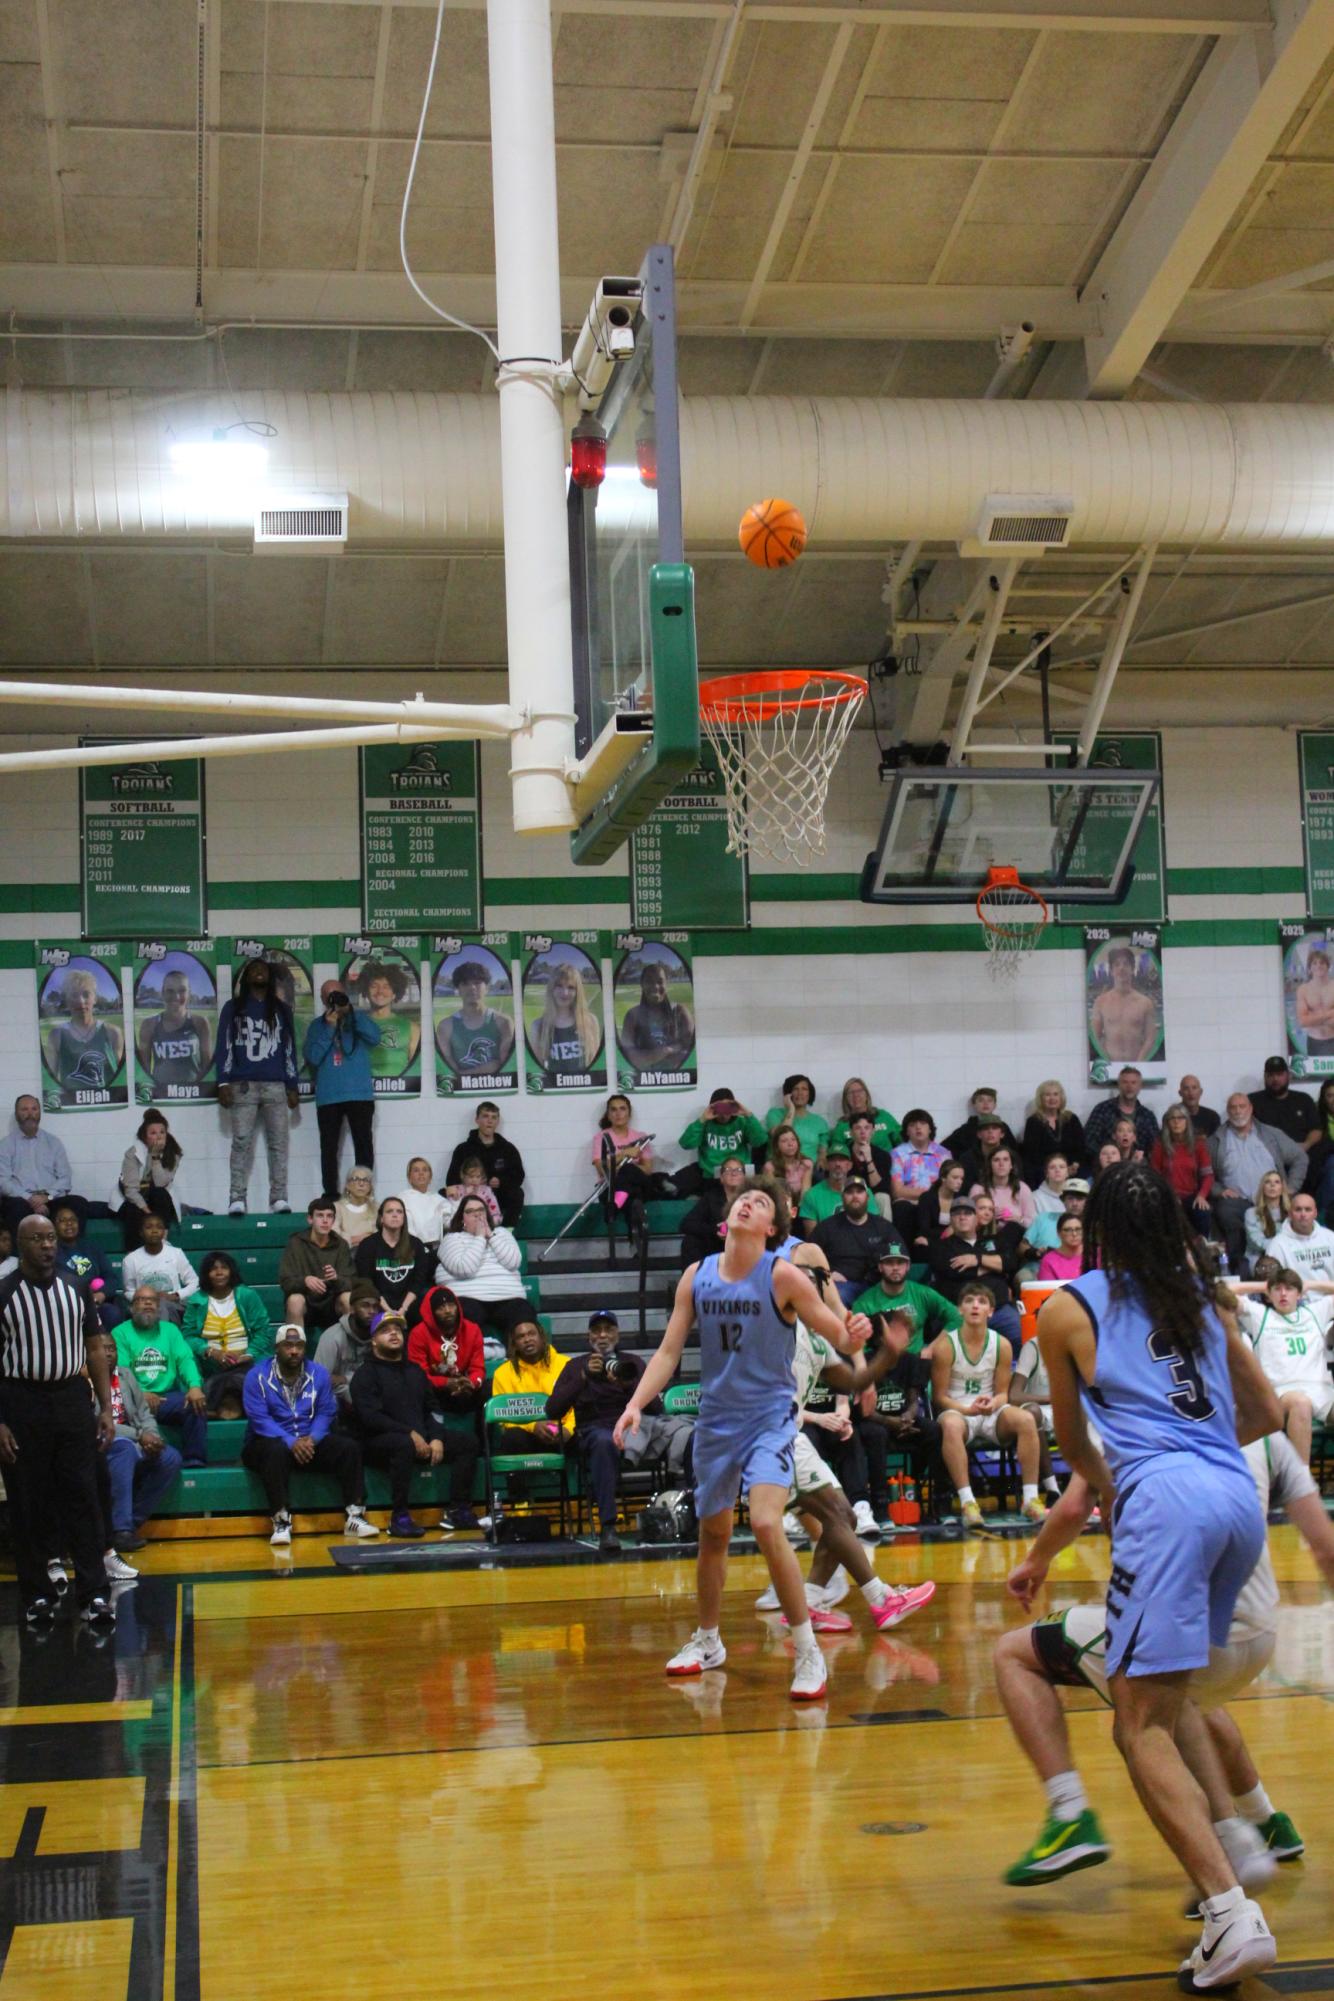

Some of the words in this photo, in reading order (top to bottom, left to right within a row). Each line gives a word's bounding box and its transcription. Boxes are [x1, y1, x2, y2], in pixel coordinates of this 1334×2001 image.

[112, 776, 173, 793] TROJANS
[390, 773, 451, 791] TROJANS
[109, 802, 175, 813] SOFTBALL
[389, 799, 452, 810] BASEBALL
[88, 819, 144, 828] CONFERENCE
[146, 819, 197, 828] CHAMPIONS
[368, 815, 423, 824] CONFERENCE
[425, 815, 474, 823] CHAMPIONS
[88, 831, 114, 841] 1989
[120, 830, 146, 841] 2017
[368, 826, 392, 837] 1983
[408, 826, 434, 838] 2010
[675, 825, 701, 836] 2012
[368, 840, 394, 850] 1984
[409, 840, 435, 850] 2013
[636, 837, 661, 849] 1981
[88, 844, 113, 855] 1992
[637, 850, 661, 861] 1988
[88, 857, 114, 868] 2010
[368, 853, 396, 864] 2008
[409, 853, 435, 864] 2016
[375, 869, 418, 878] REGIONAL
[420, 869, 469, 878] CHAMPIONS
[637, 863, 661, 875] 1992
[88, 871, 113, 881] 2011
[637, 876, 662, 888] 1993
[95, 884, 138, 893] REGIONAL
[140, 885, 191, 894] CHAMPIONS
[368, 879, 396, 891] 2004
[638, 889, 663, 901] 1994
[374, 908, 420, 917] SECTIONAL
[422, 908, 472, 917] CHAMPIONS
[638, 902, 662, 913] 1995
[369, 919, 396, 930] 2004
[638, 915, 662, 927] 1997
[1086, 928, 1110, 940] 2025
[1282, 924, 1305, 937] 2025
[391, 935, 419, 948] 2025
[481, 933, 508, 945] 2025
[571, 931, 598, 944] 2025
[662, 931, 689, 943] 2025
[90, 944, 118, 957] 2025
[186, 940, 214, 952] 2025
[283, 938, 310, 951] 2025
[154, 1039, 200, 1059] WEST
[461, 1075, 512, 1088] Matthew
[556, 1073, 591, 1086] Emma
[640, 1071, 690, 1085] AhYanna
[76, 1089, 111, 1104] Elijah
[167, 1084, 200, 1097] Maya
[706, 1130, 743, 1151] WEST
[702, 1300, 761, 1316] VIKINGS
[719, 1322, 744, 1353] 12
[1286, 1337, 1307, 1356] 30
[1145, 1327, 1217, 1423] 3
[964, 1378, 982, 1395] 15
[508, 1398, 535, 1408] WEST
[494, 1406, 546, 1417] BRUNSWIC
